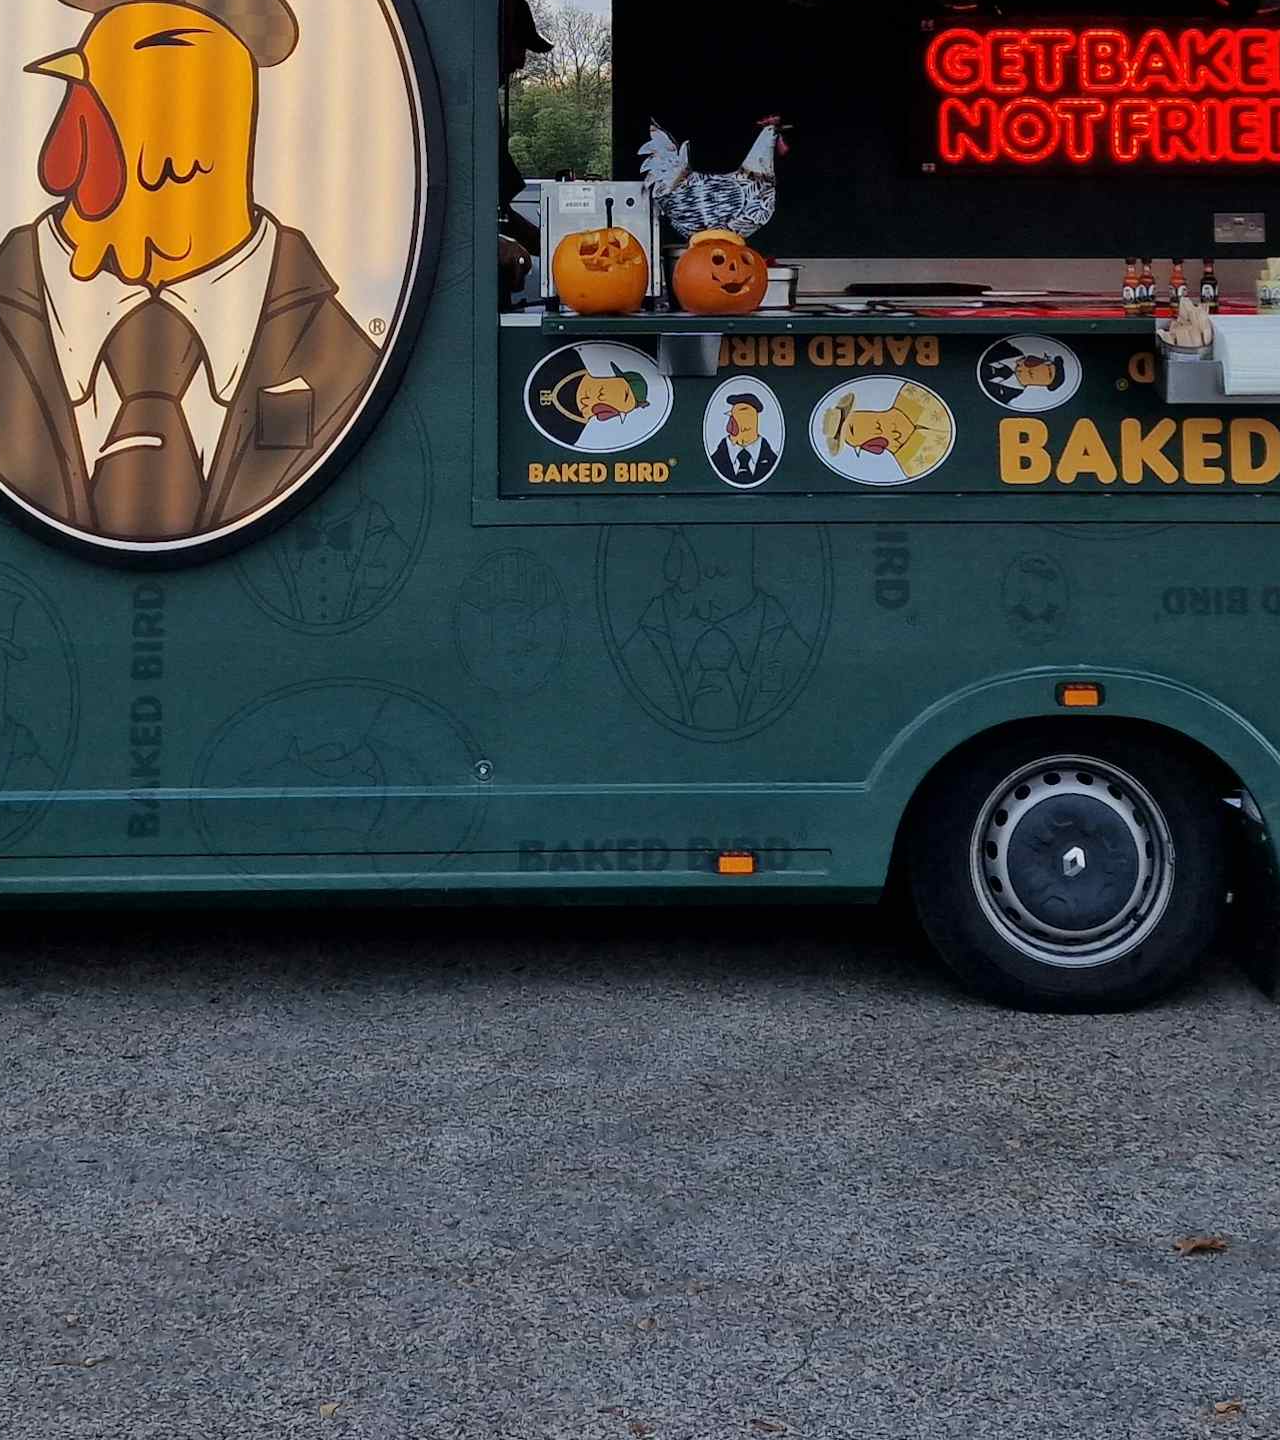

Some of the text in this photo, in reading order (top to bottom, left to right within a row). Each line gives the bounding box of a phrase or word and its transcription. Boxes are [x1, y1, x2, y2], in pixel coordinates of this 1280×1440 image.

[927, 28, 1076, 93] GET
[939, 96, 1107, 163] NOT
[807, 335, 941, 368] BAKED
[528, 462, 609, 483] BAKED
[130, 581, 166, 681] BIRD
